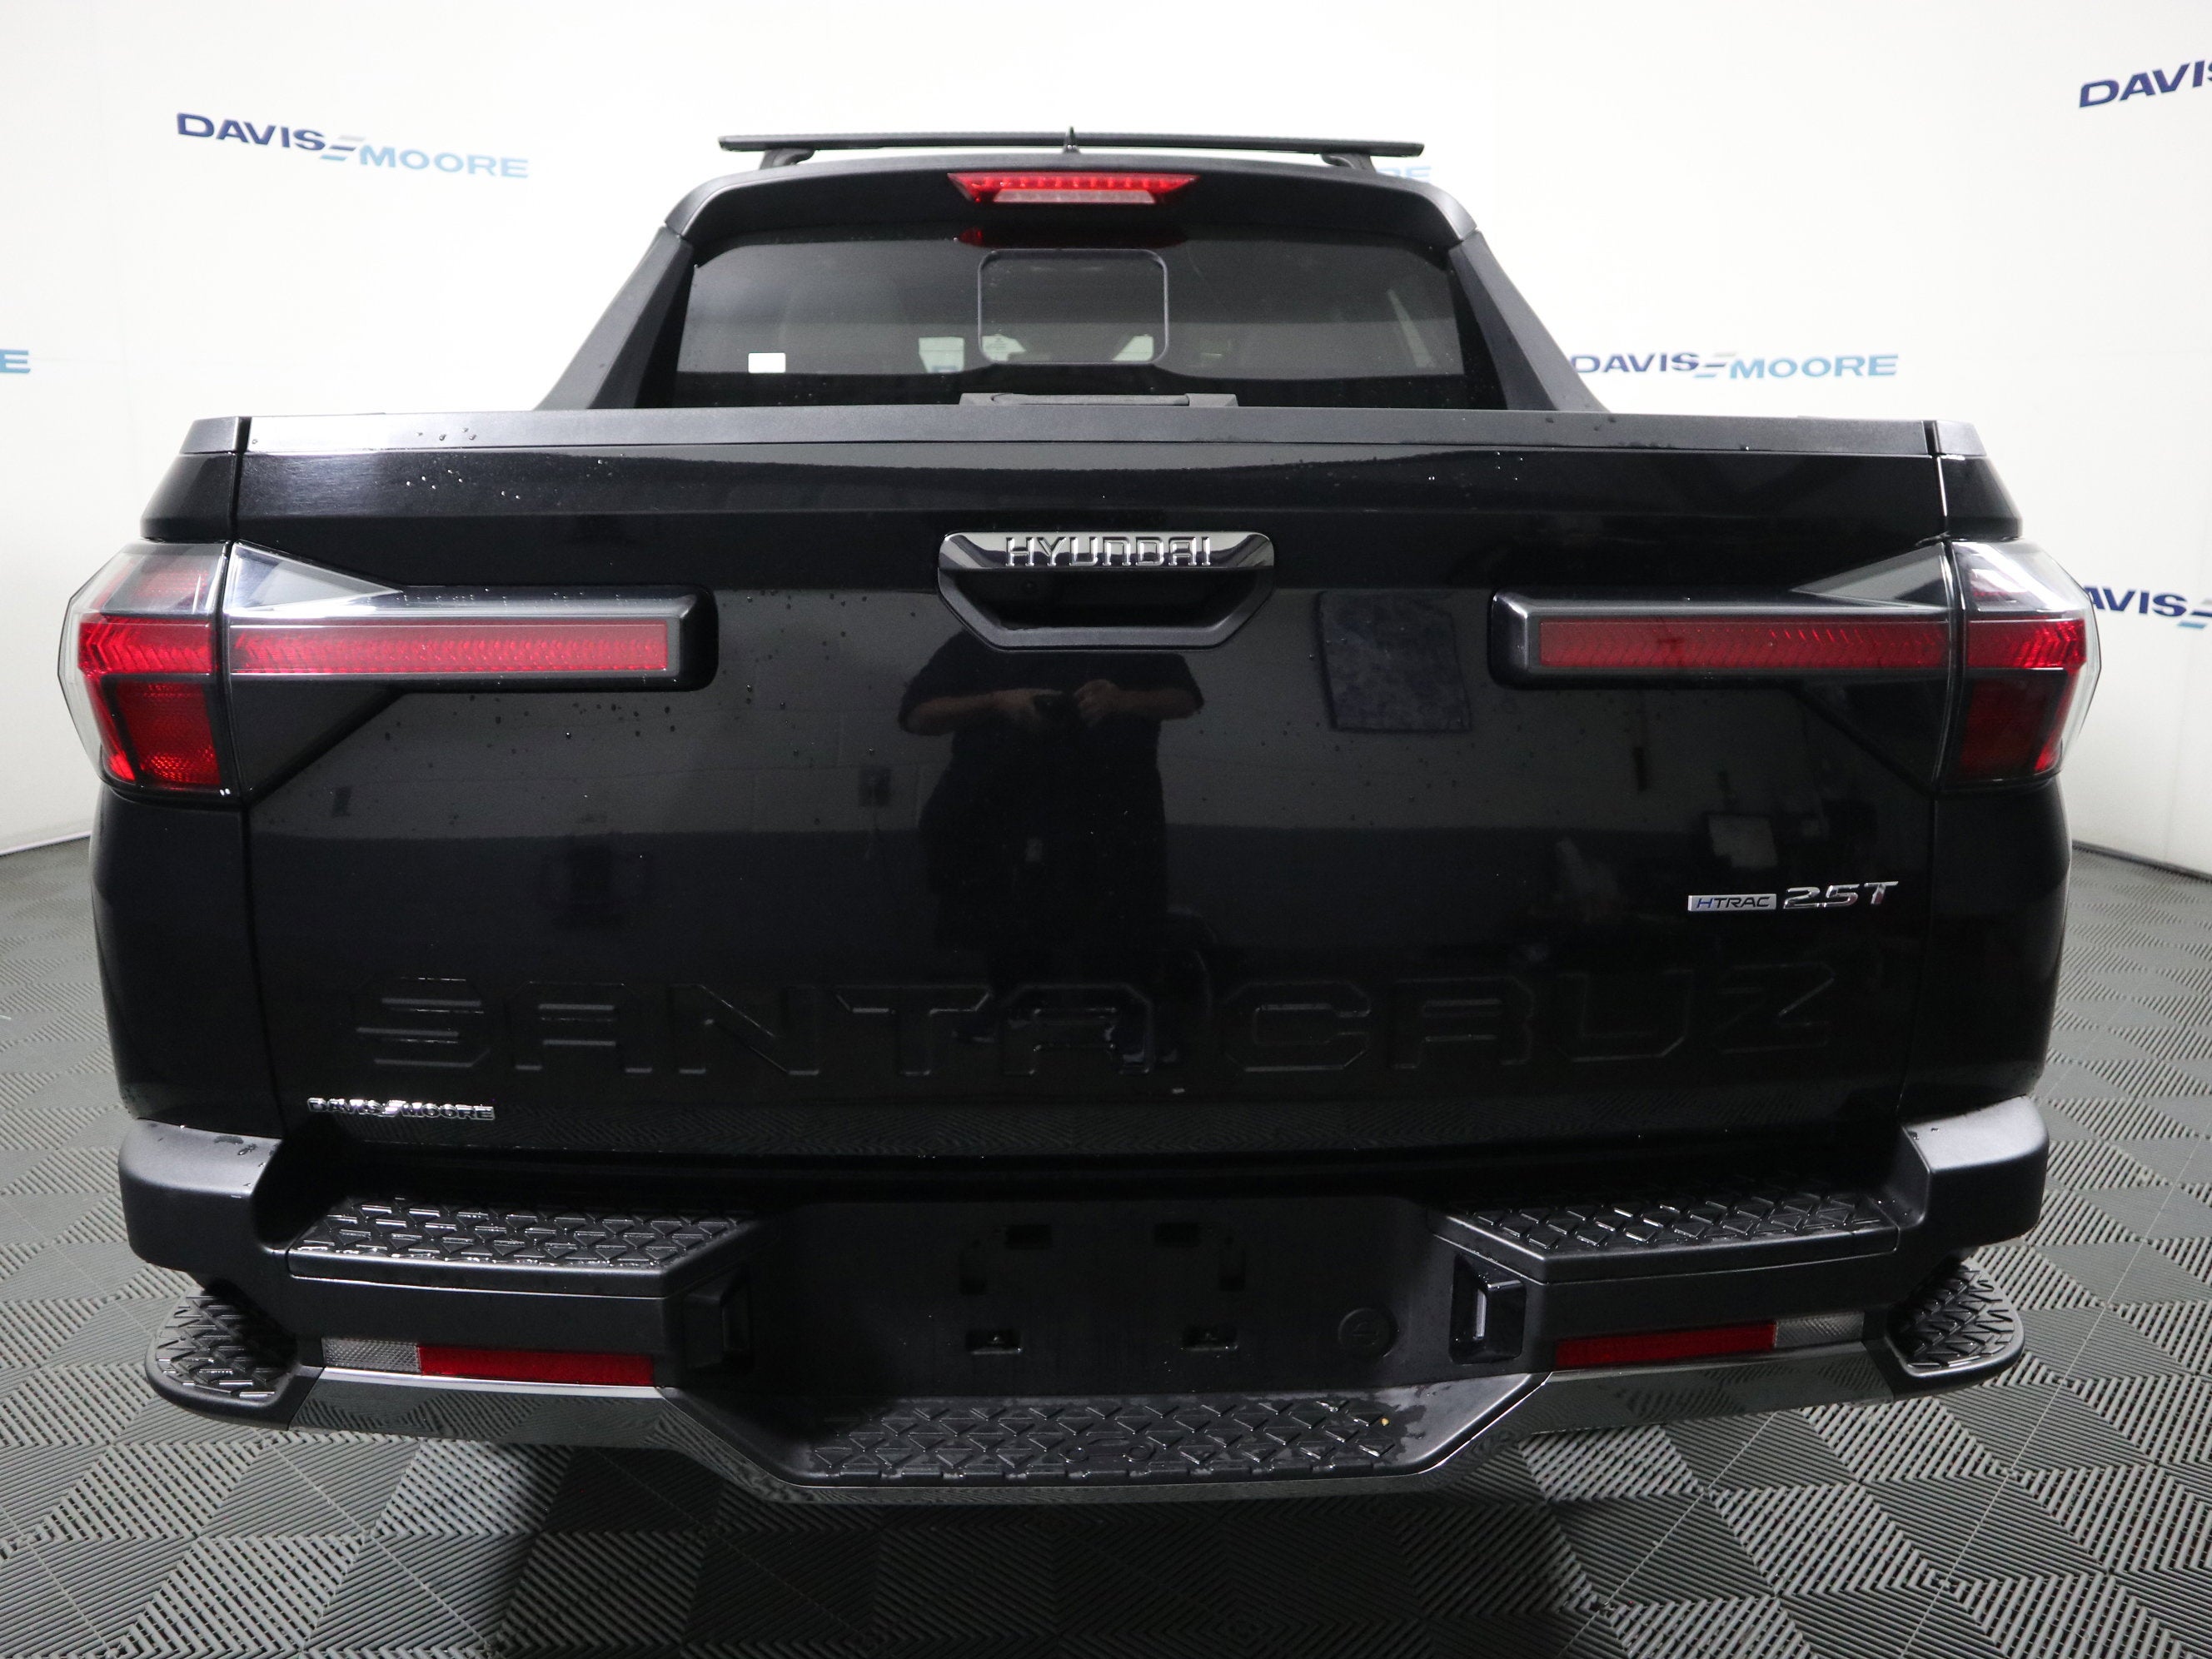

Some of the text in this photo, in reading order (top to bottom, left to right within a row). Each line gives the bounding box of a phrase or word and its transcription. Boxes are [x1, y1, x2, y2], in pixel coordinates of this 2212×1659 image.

[2079, 59, 2212, 107] DAVI
[177, 112, 529, 179] DAVIS MOORE
[1570, 351, 1898, 380] DAVIS MOORE
[1005, 536, 1212, 567] HYUNDAI
[2083, 585, 2188, 618] AVIS
[1696, 896, 1771, 909] HTRAC
[351, 960, 1837, 1078] SANTA CRUZ
[400, 1101, 496, 1121] MOORE
